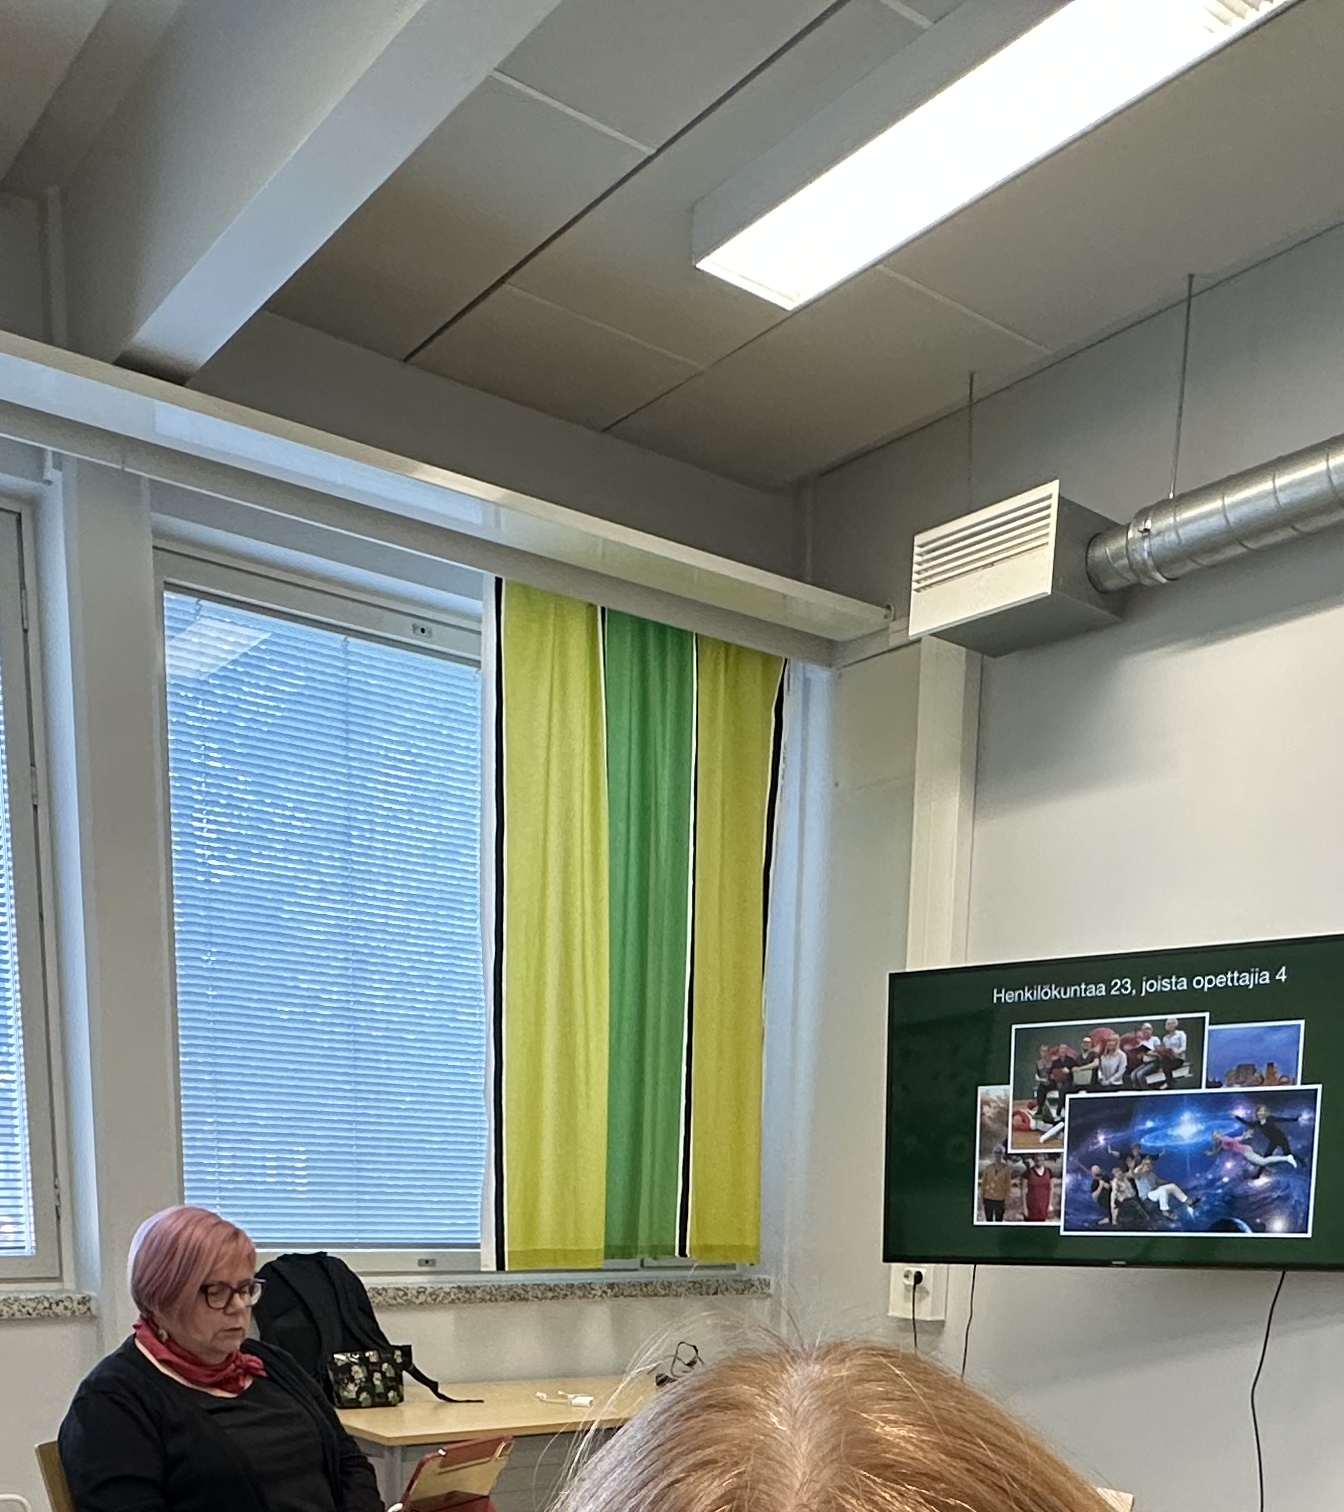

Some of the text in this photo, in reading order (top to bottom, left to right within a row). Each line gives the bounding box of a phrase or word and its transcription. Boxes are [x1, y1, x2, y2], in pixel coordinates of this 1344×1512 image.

[993, 966, 1287, 1003] Henkilökuntaa 23, joista opettajia 4
